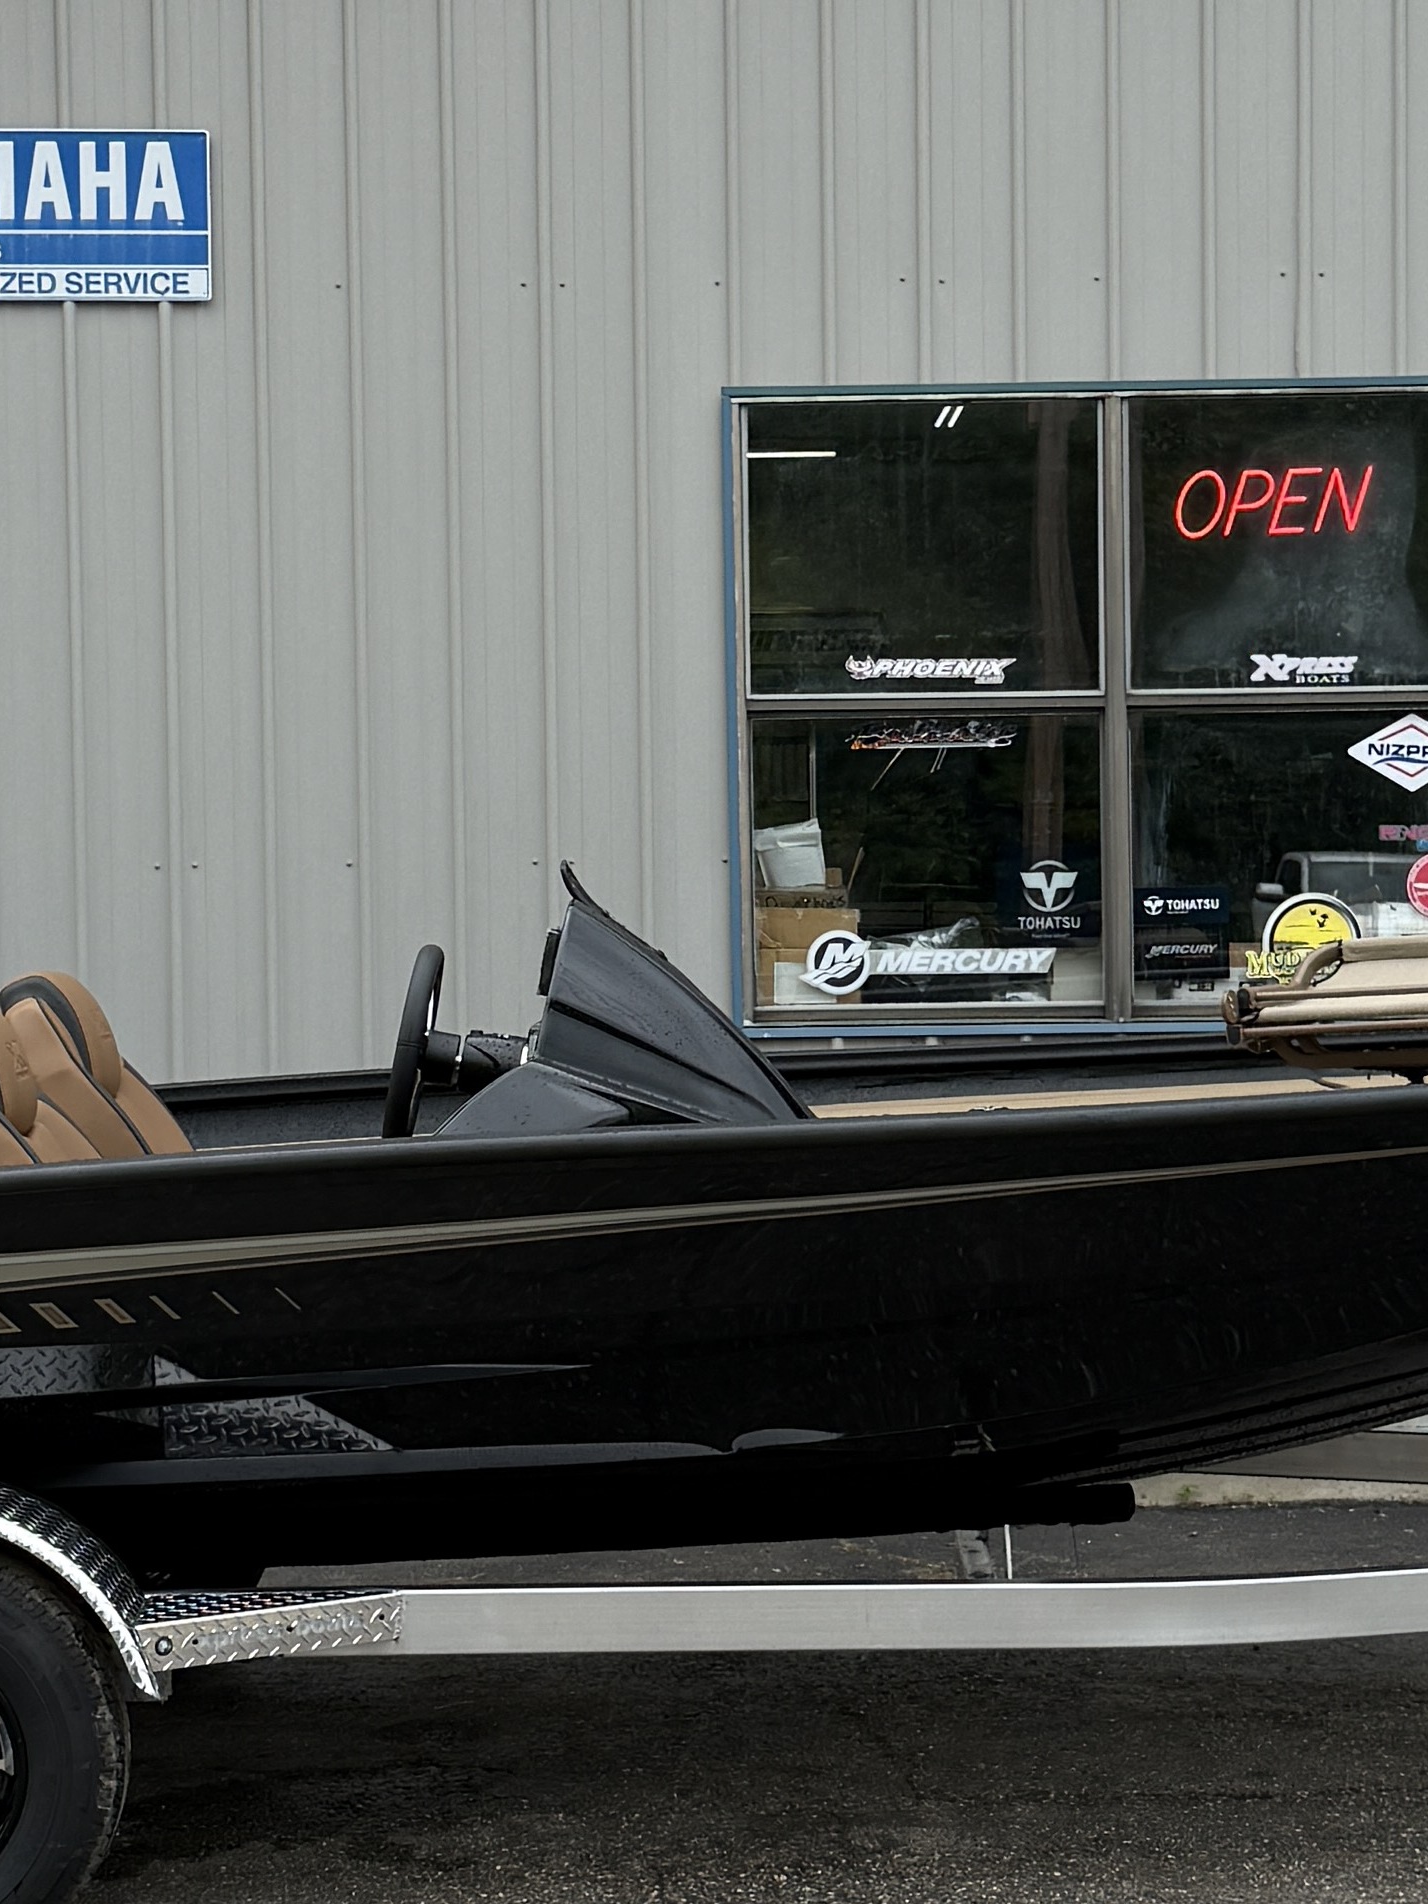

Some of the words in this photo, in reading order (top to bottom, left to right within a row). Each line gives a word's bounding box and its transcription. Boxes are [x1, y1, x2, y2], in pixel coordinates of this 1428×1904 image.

[65, 271, 190, 295] SERVICE
[1174, 464, 1373, 540] OPEN
[872, 657, 1017, 679] PHOENIX
[1295, 673, 1350, 684] BOATS
[1166, 898, 1219, 911] TOHATSU
[1017, 916, 1081, 931] TOHATSU
[1146, 944, 1218, 959] MERCURY
[876, 949, 1055, 973] MERCURY
